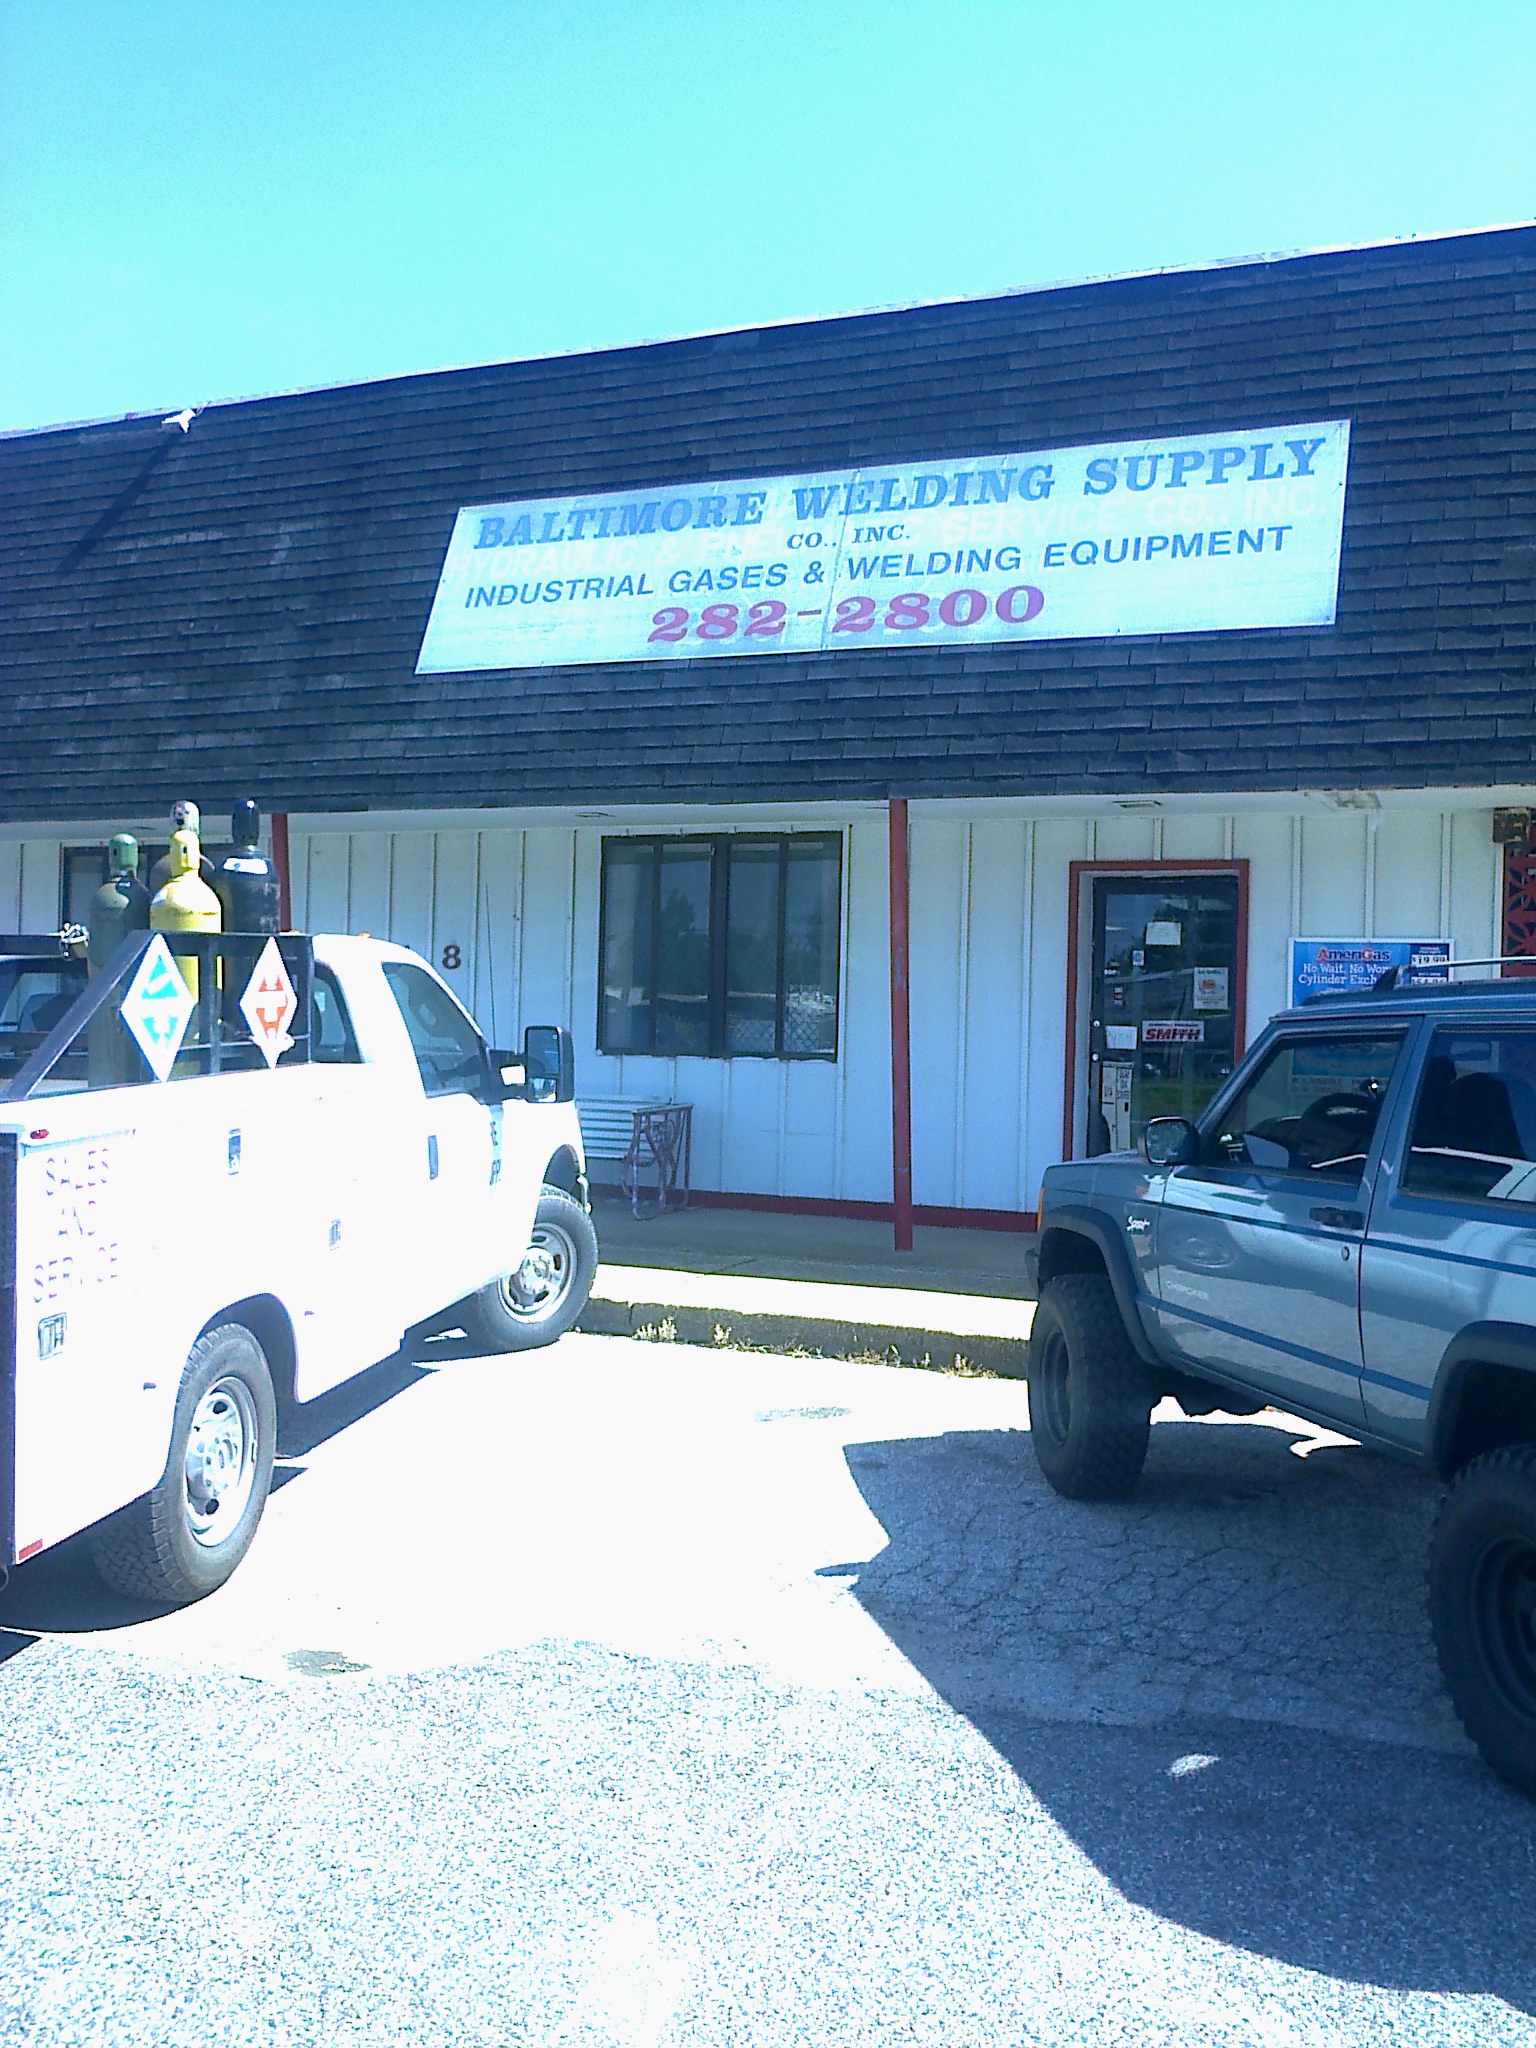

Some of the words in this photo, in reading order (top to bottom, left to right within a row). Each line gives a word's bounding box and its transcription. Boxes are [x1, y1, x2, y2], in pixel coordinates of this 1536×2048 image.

[473, 491, 767, 550] BALTIMORE
[791, 464, 1056, 521] WELDING
[1083, 437, 1327, 497] SUPPLY
[851, 524, 911, 544] INC.
[464, 572, 654, 609] INDUSTRIAL
[667, 562, 787, 594] GASES
[803, 560, 825, 585] &
[846, 546, 1022, 581] WELDING
[1043, 524, 1293, 569] EQUIPMENT
[647, 584, 1046, 644] 282-2800
[442, 944, 462, 970] 8
[1303, 963, 1318, 974] No
[1350, 963, 1364, 974] No
[1298, 974, 1347, 986] Cylinder
[1350, 974, 1378, 985] Exch
[1145, 1028, 1201, 1040] SMITH
[33, 1242, 119, 1304] SERCE
